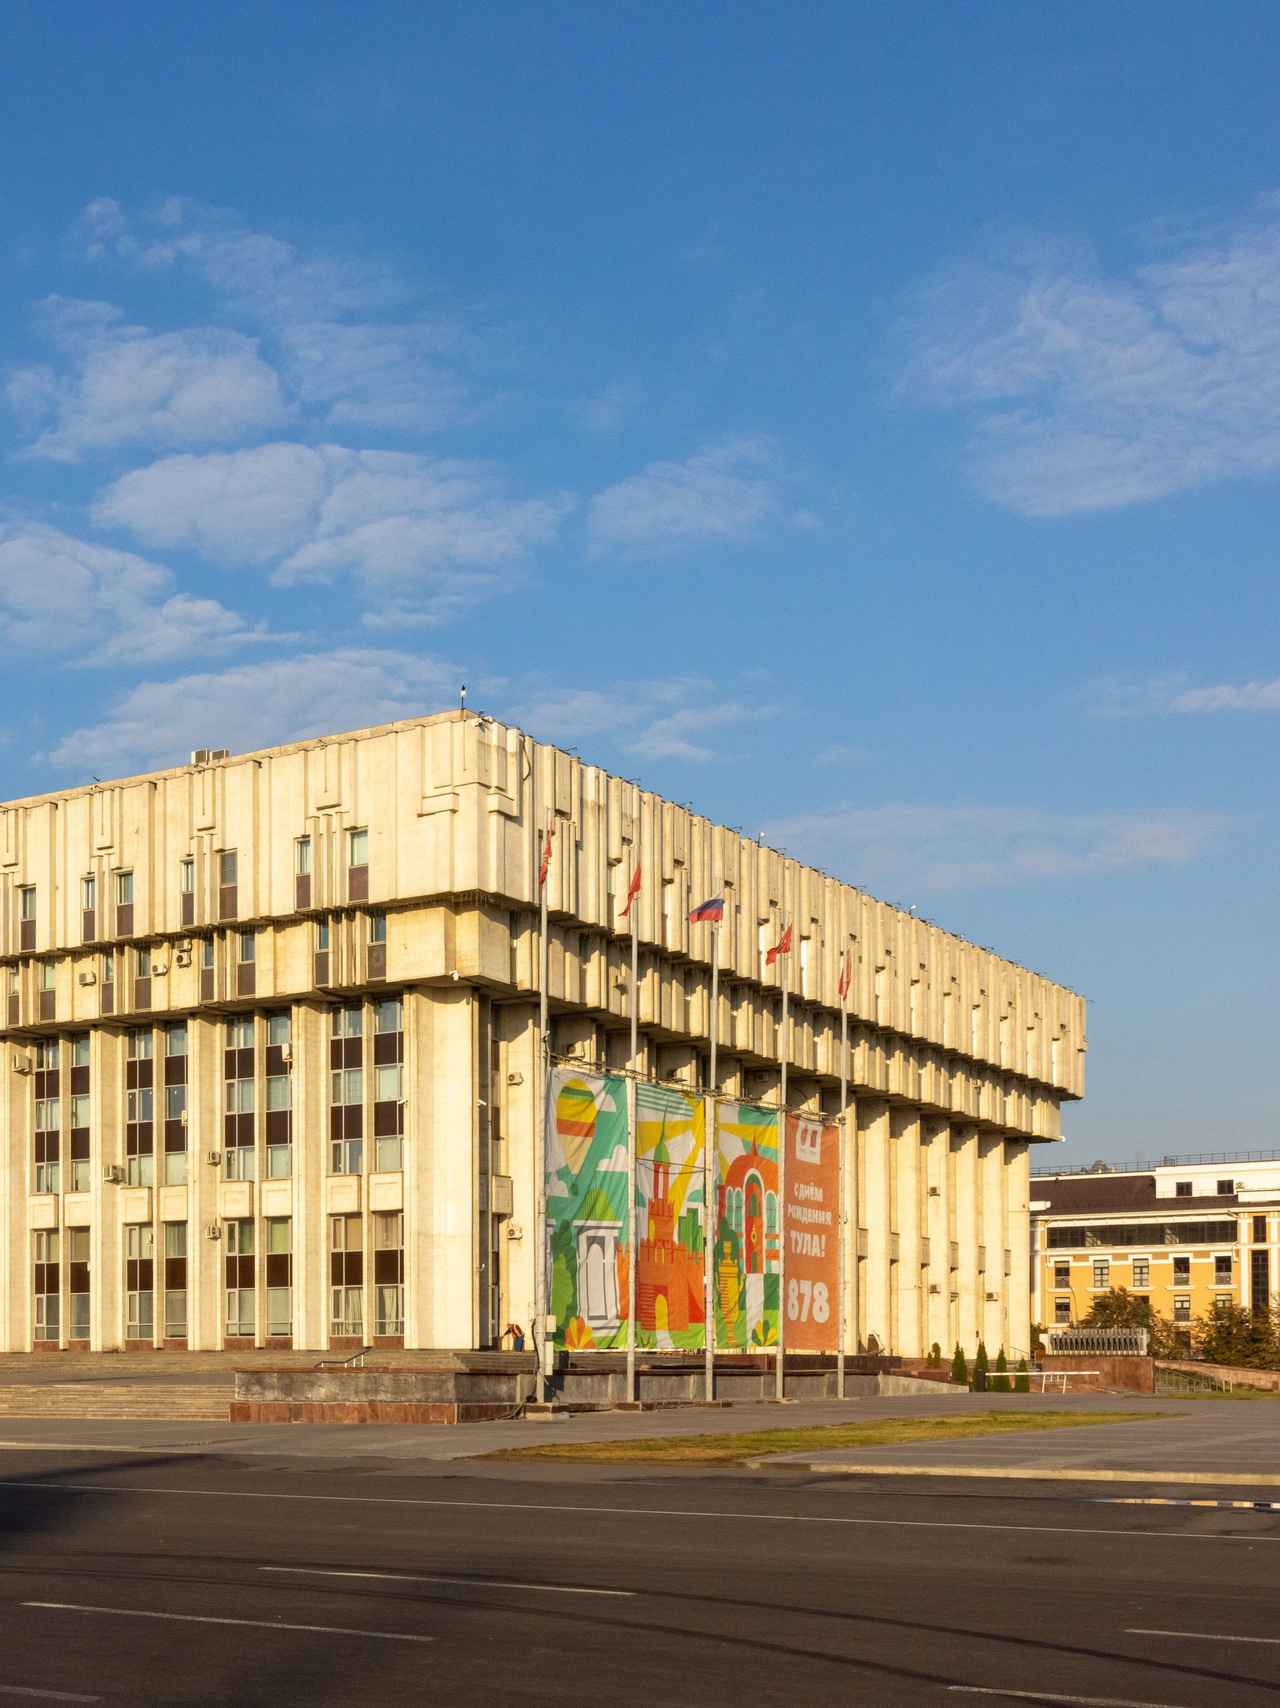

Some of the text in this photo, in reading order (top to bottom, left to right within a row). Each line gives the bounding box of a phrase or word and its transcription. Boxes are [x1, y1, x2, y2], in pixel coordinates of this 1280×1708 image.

[793, 1182, 823, 1202] С ДНЁМ
[787, 1203, 833, 1226] РОЖДЕНИЯ,
[790, 1230, 826, 1258] ТУЛА!
[787, 1278, 830, 1324] 878
